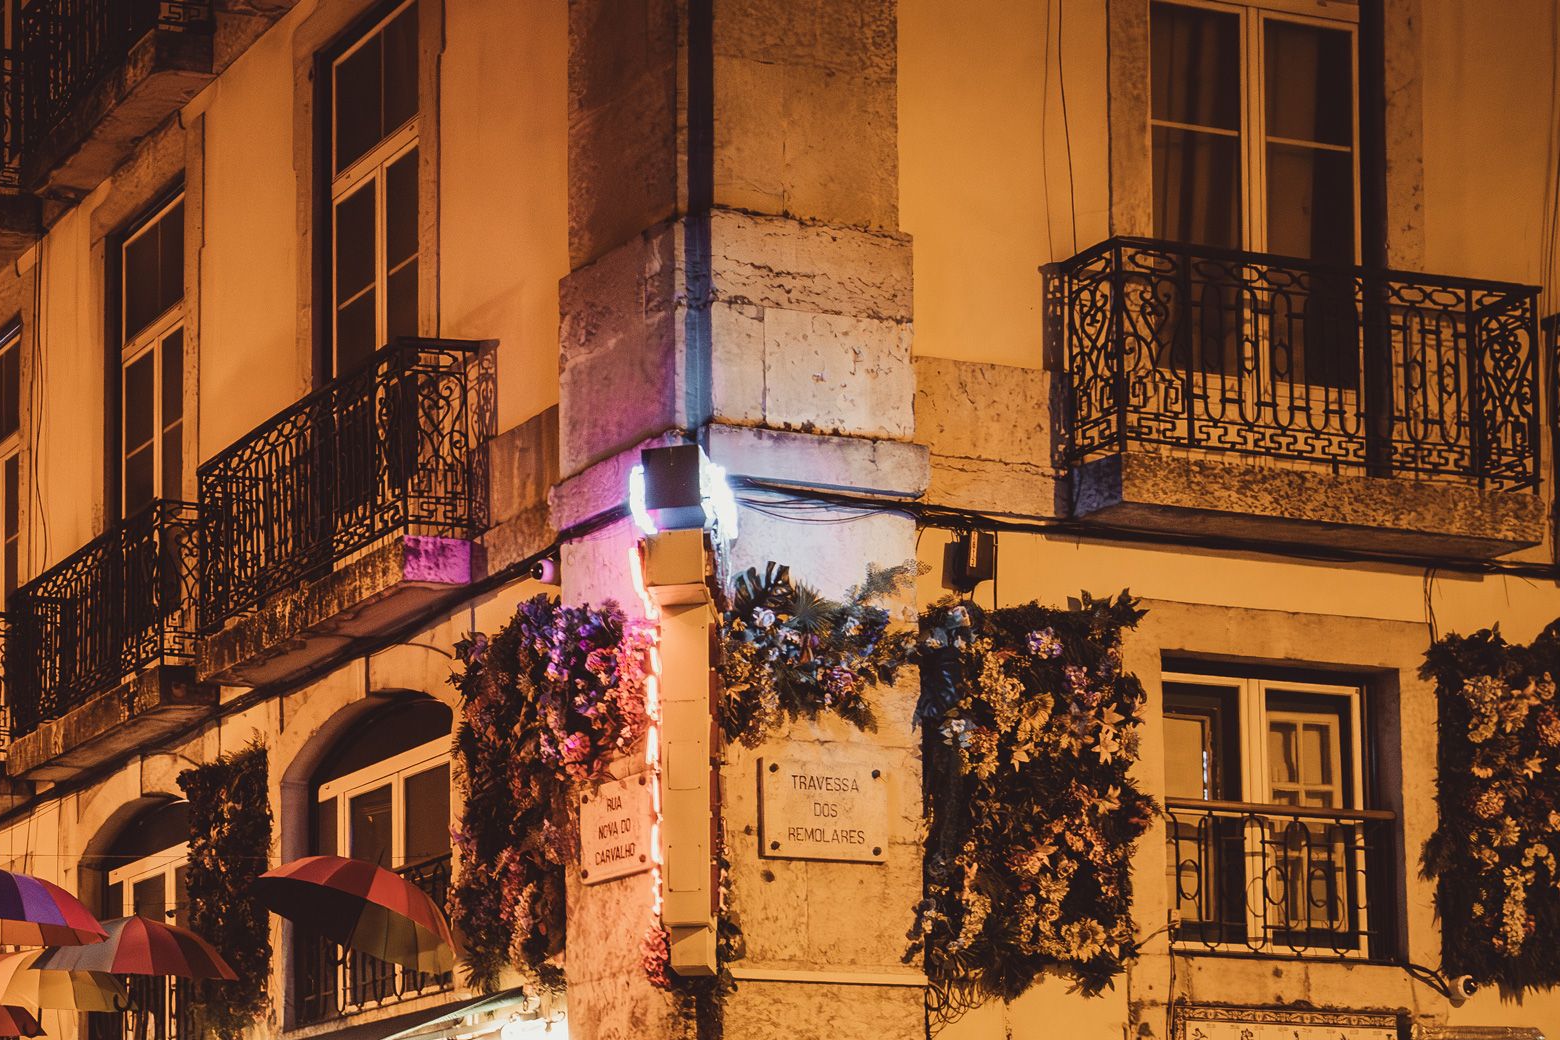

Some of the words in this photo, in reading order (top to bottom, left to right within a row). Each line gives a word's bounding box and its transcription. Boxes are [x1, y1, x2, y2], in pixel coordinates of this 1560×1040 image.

[791, 774, 860, 792] TRAVESSA
[606, 795, 622, 812] RUA
[813, 802, 838, 818] DOS
[598, 821, 619, 840] NOVA
[621, 818, 631, 834] DO
[788, 826, 866, 844] REMOLARES
[595, 842, 636, 866] CARVALHO
